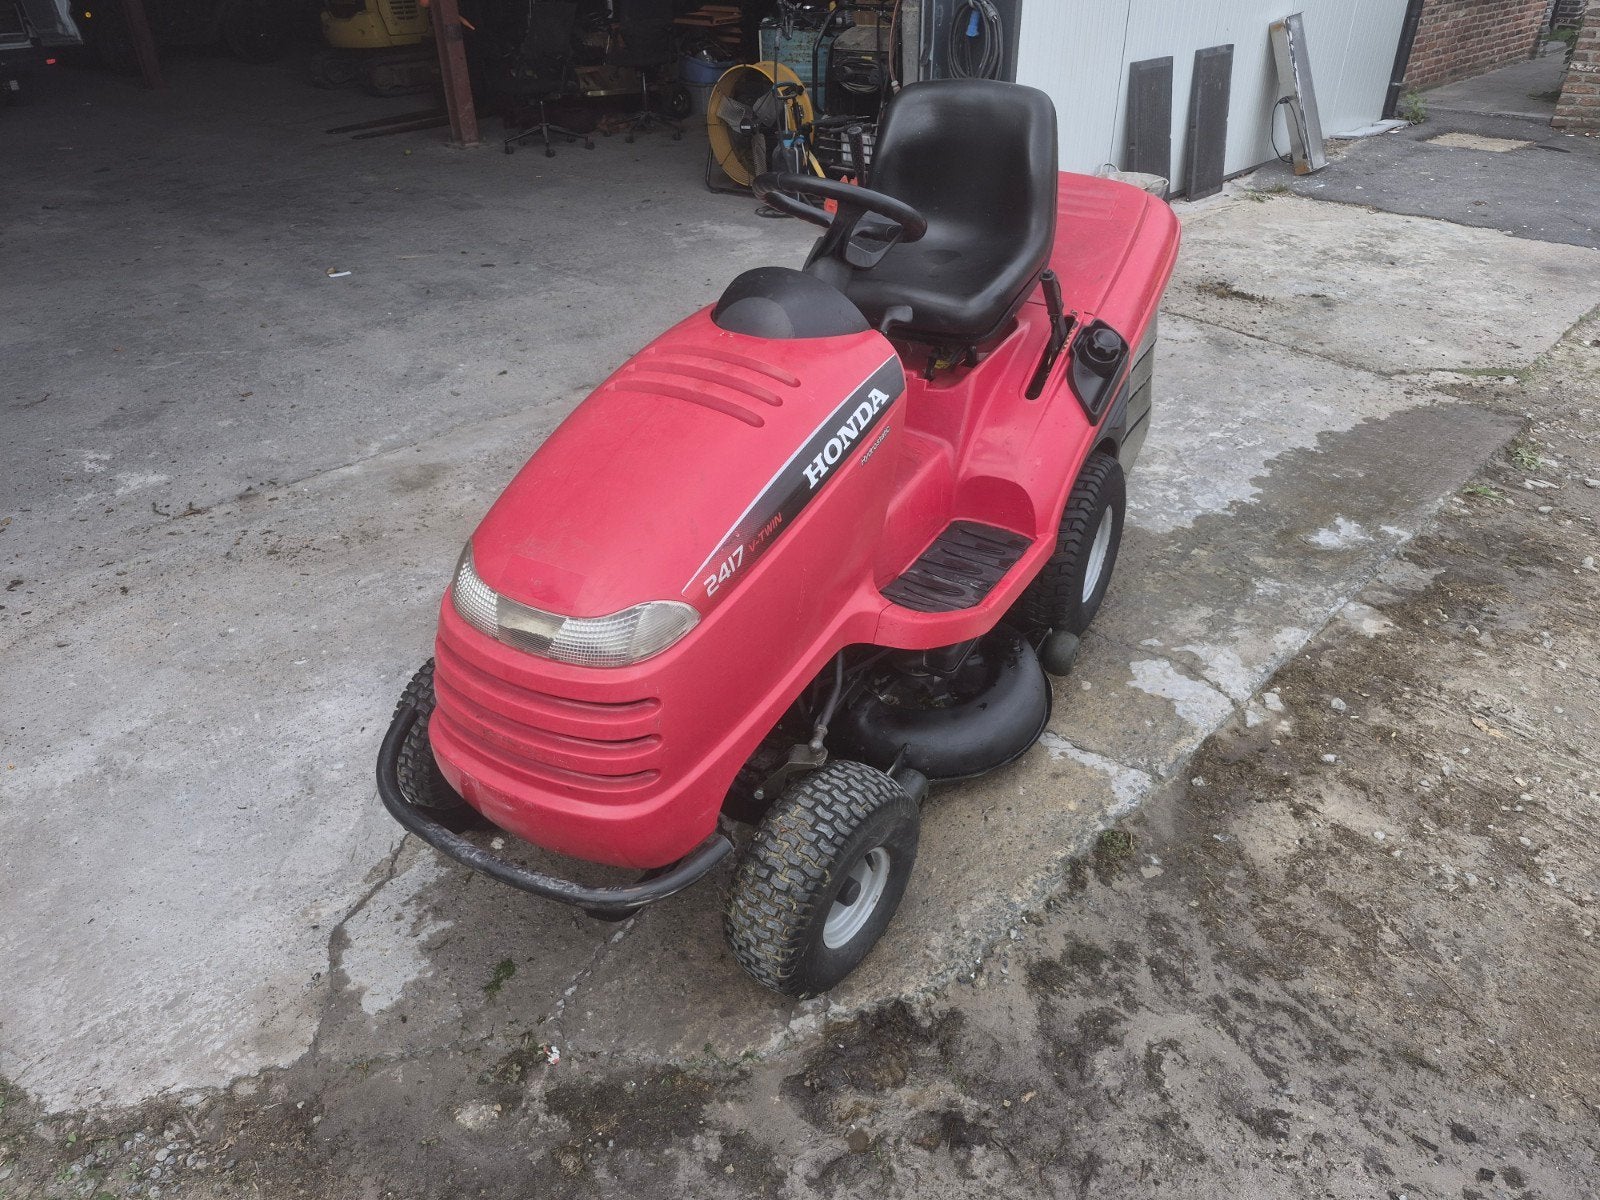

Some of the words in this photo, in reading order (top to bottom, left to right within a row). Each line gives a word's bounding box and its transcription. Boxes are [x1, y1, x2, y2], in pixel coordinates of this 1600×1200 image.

[803, 388, 889, 489] HONDA
[703, 545, 745, 597] 2417
[748, 512, 783, 552] V-TWIN
